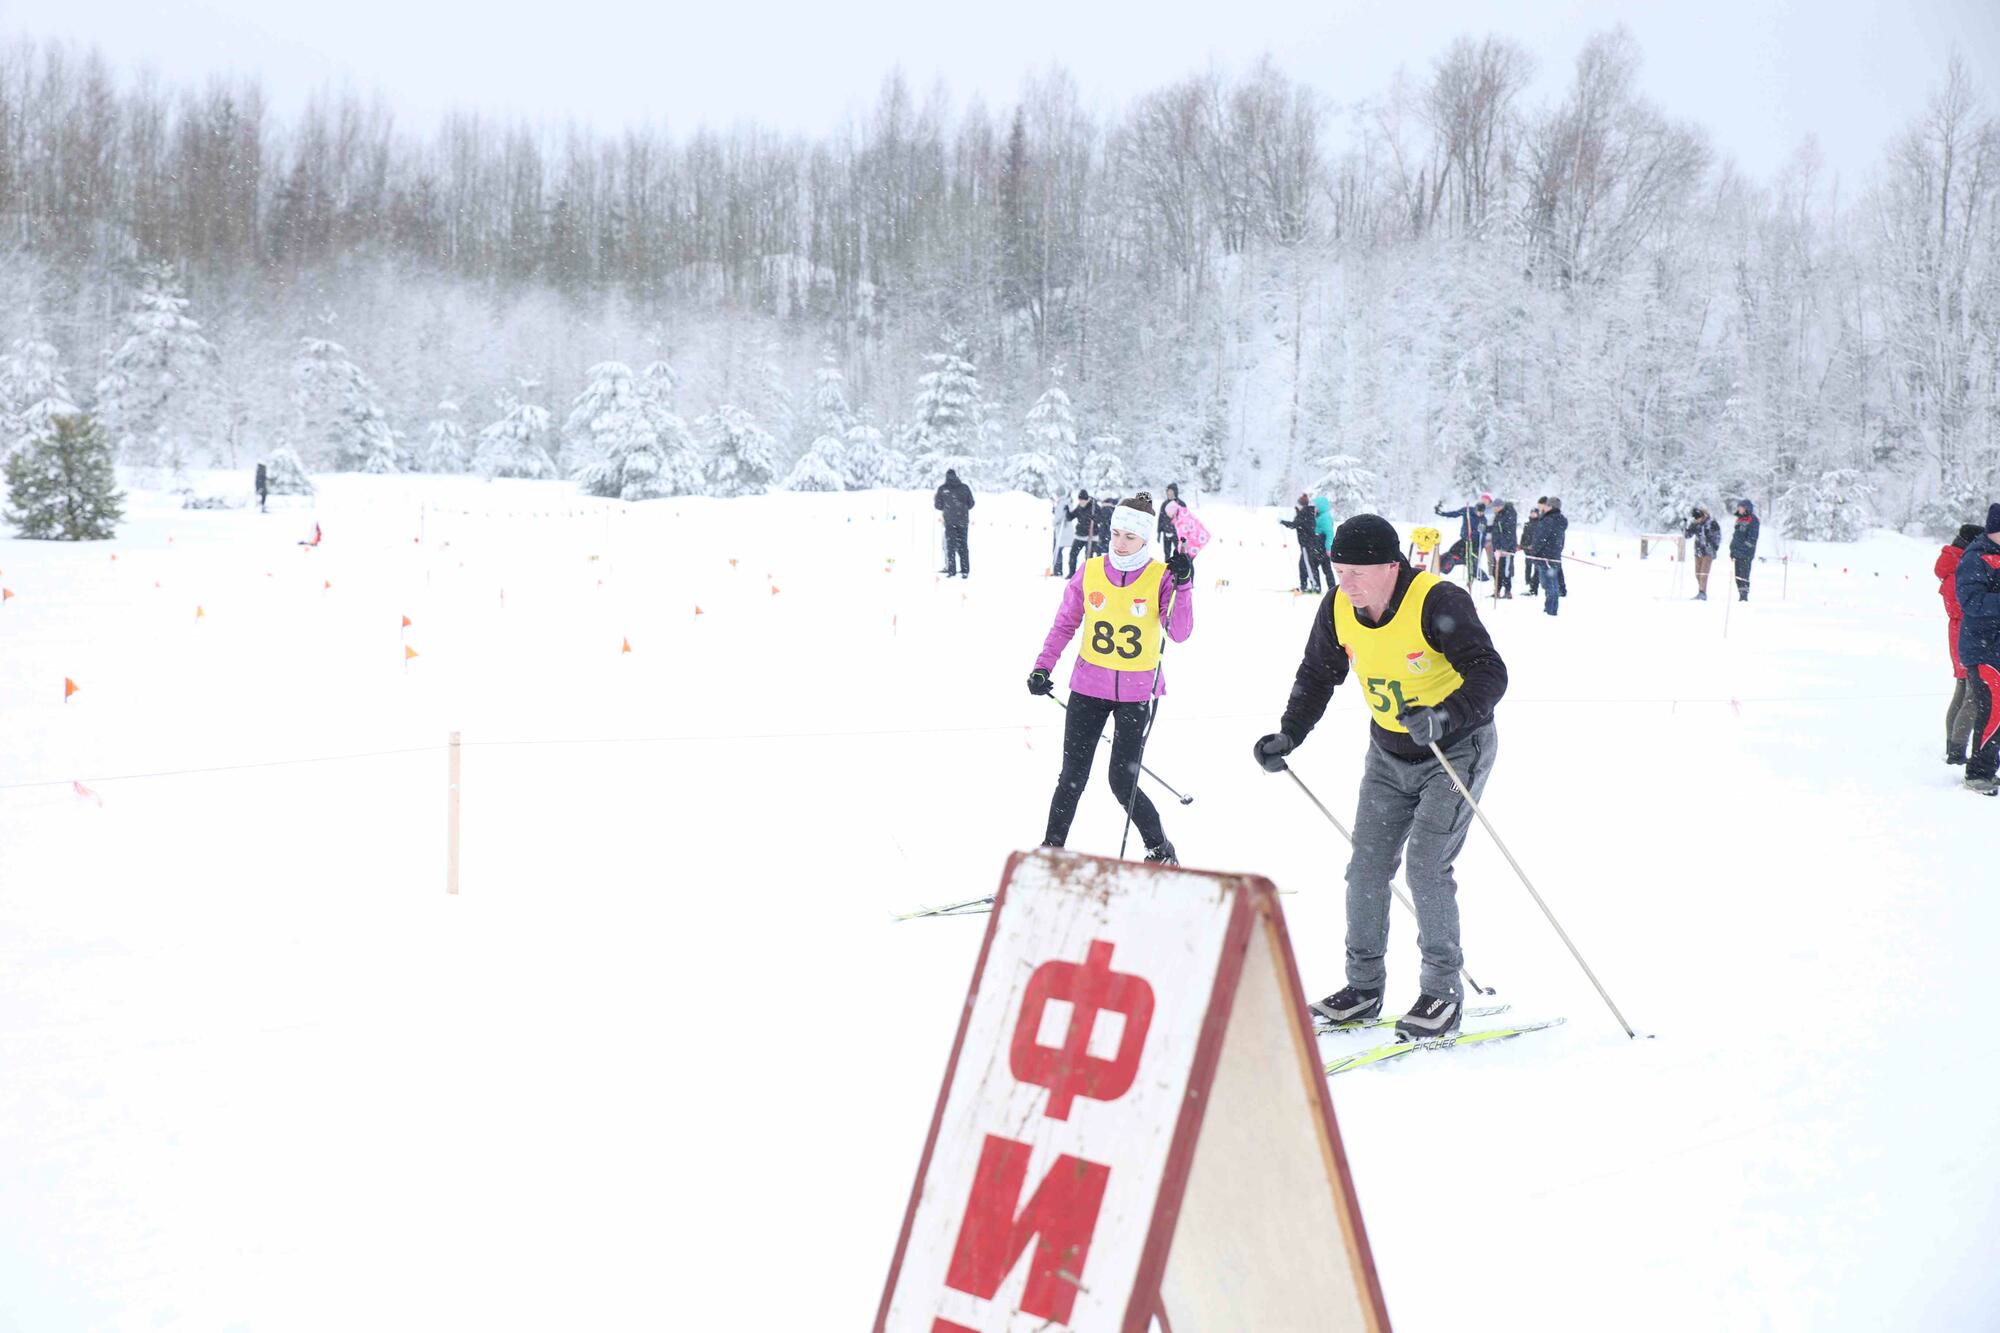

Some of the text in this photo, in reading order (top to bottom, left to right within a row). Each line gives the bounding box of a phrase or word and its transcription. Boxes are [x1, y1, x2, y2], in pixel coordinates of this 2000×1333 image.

[1092, 620, 1142, 659] 83
[1367, 677, 1405, 715] 51
[1411, 1038, 1456, 1053] FISCHER
[931, 938, 1155, 1333] ФИ
